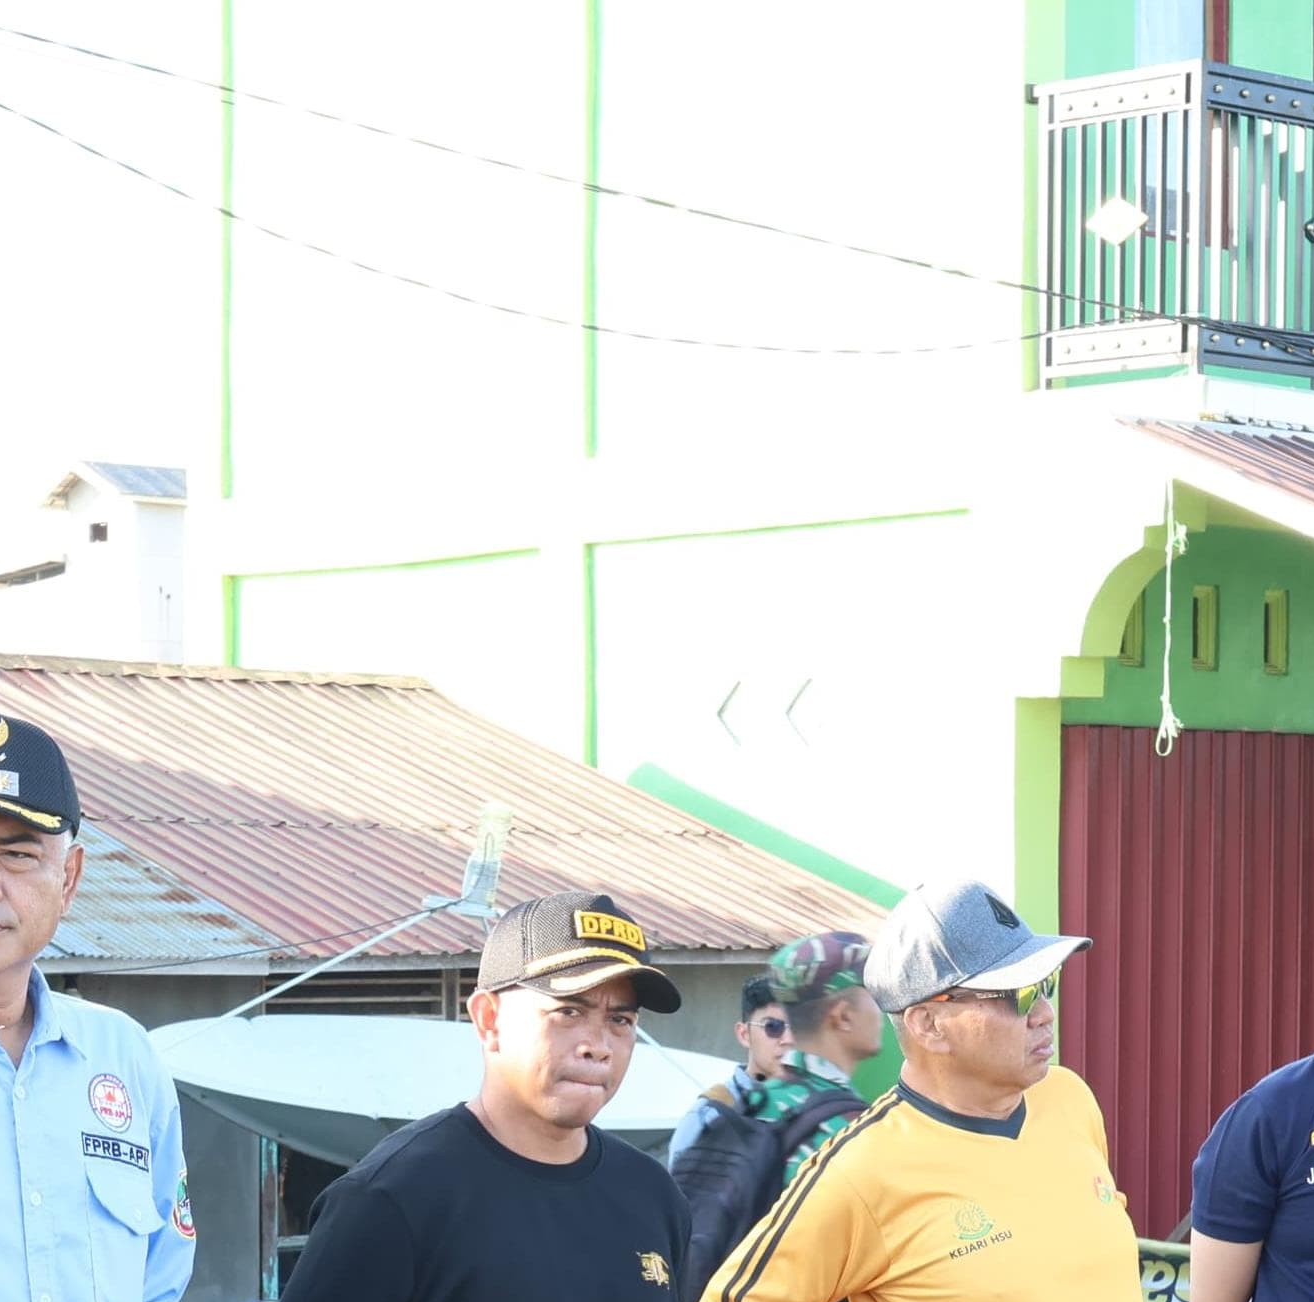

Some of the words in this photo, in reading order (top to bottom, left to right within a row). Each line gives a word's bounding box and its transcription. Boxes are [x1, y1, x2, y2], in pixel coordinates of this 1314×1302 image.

[584, 916, 640, 944] DPRD
[949, 1238, 988, 1260] KEJARI
[989, 1230, 1013, 1245] HSU
